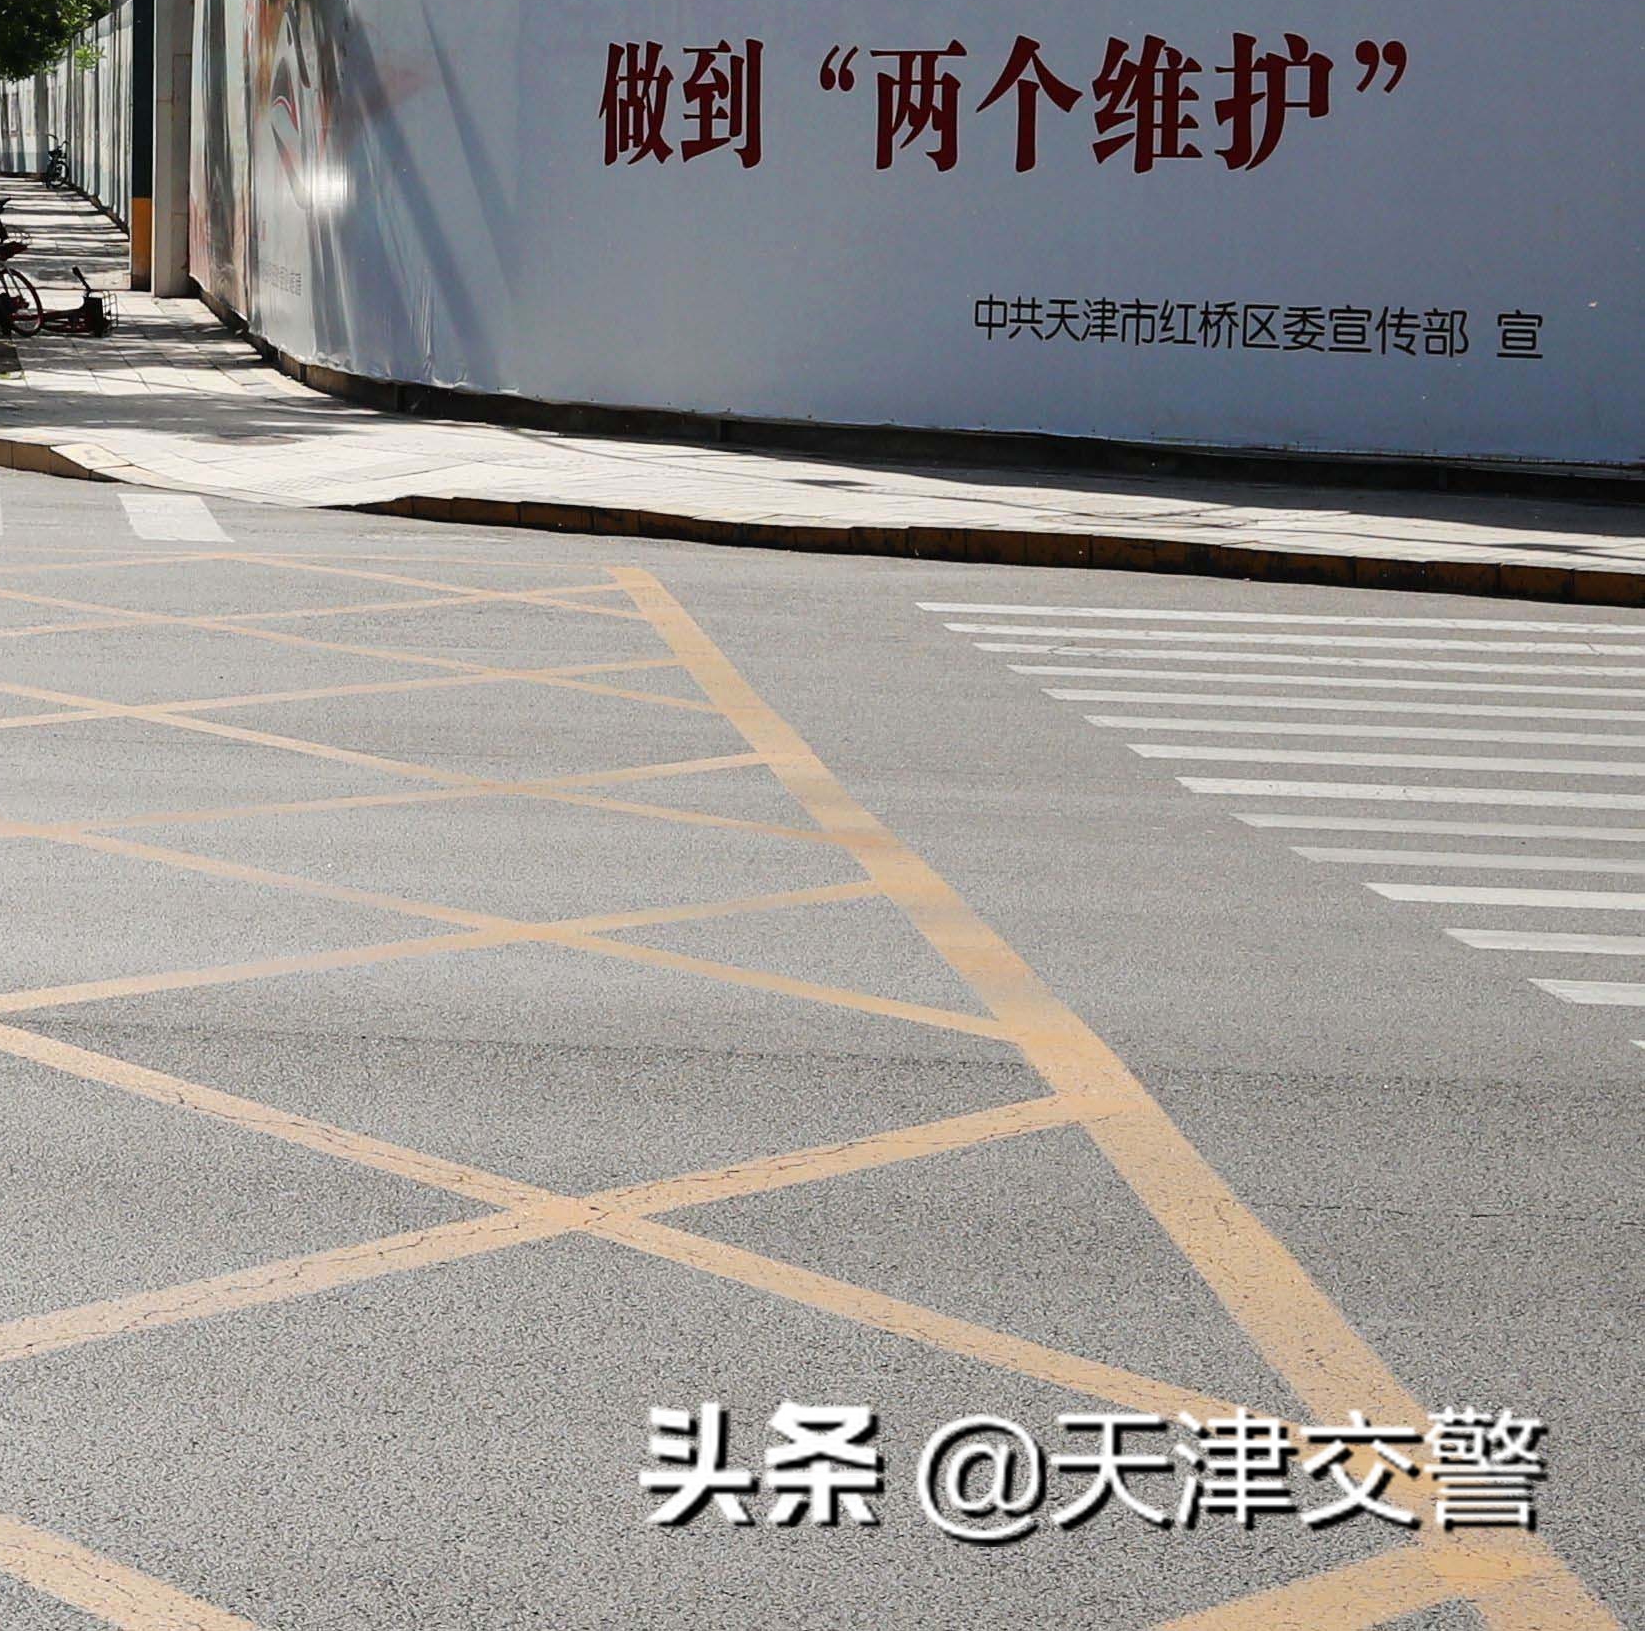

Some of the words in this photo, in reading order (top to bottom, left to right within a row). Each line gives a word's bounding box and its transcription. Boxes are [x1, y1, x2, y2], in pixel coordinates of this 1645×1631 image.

[974, 293, 1470, 359] 中共天津市红桥区委宣传部
[1496, 308, 1544, 360] 宣
